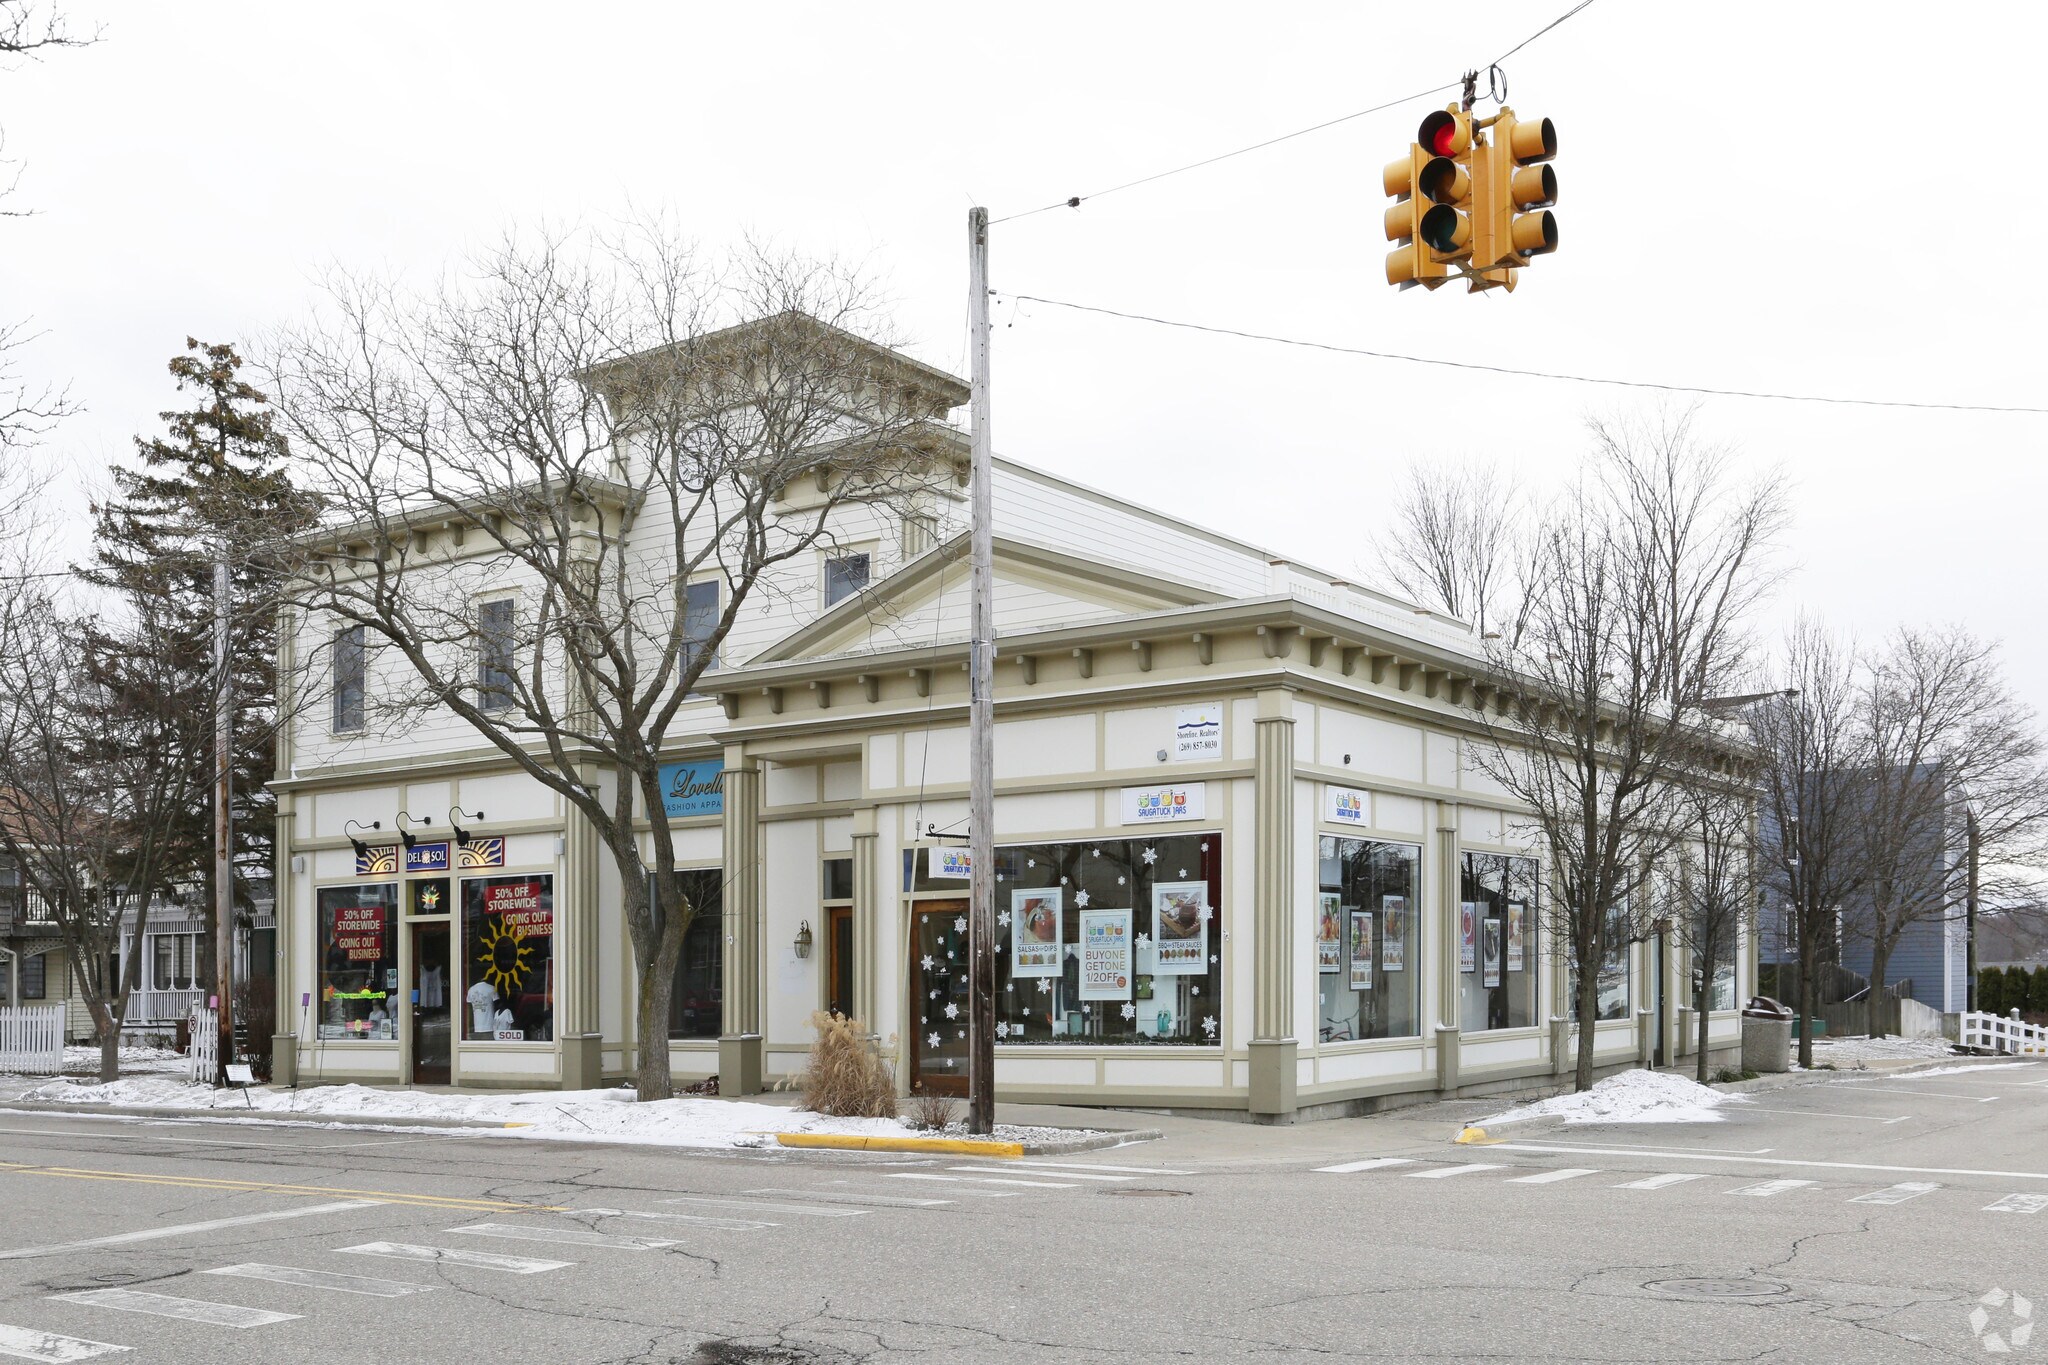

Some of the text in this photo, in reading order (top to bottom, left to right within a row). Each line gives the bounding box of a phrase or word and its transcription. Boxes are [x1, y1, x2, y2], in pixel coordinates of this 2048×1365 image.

[1138, 806, 1187, 818] SAUGATUCK JARS
[407, 850, 446, 863] DEL SOL
[495, 887, 529, 899] 50% OFF
[488, 898, 537, 911] STOREWIDE
[344, 910, 374, 920] 50% OFF
[506, 911, 547, 925] GOING OUT
[337, 920, 380, 931] STOREWIDE
[517, 924, 553, 936] BUSINESS
[339, 937, 375, 948] GOING OUT
[349, 949, 380, 959] BUSINESS
[1017, 945, 1040, 953] SALSAS
[498, 1031, 522, 1040] SOLD
